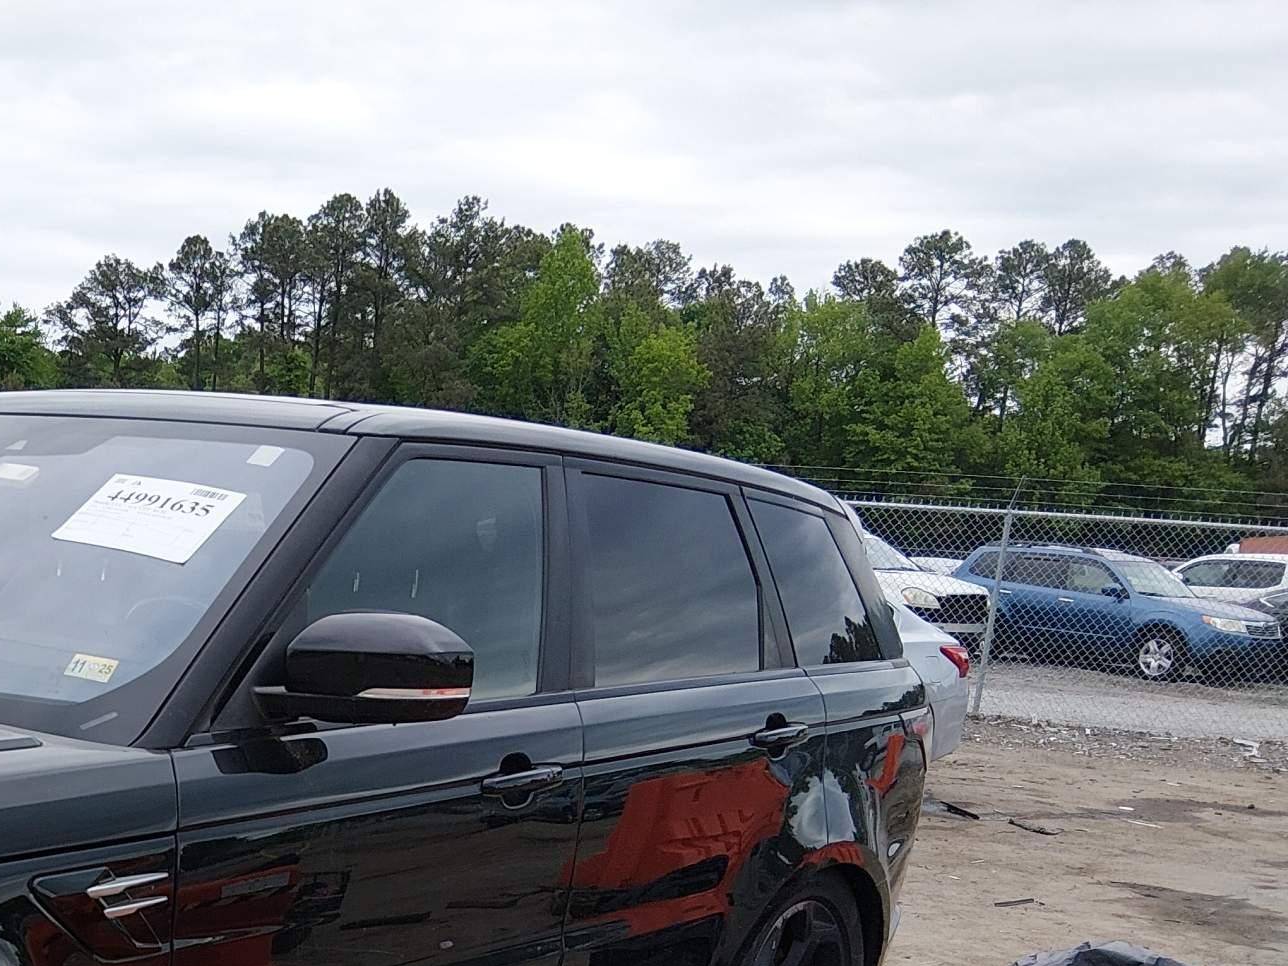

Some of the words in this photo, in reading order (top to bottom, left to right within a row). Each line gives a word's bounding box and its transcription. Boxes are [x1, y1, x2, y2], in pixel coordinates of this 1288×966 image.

[107, 490, 215, 518] 44991635
[71, 658, 87, 673] 11
[98, 663, 114, 675] 25
